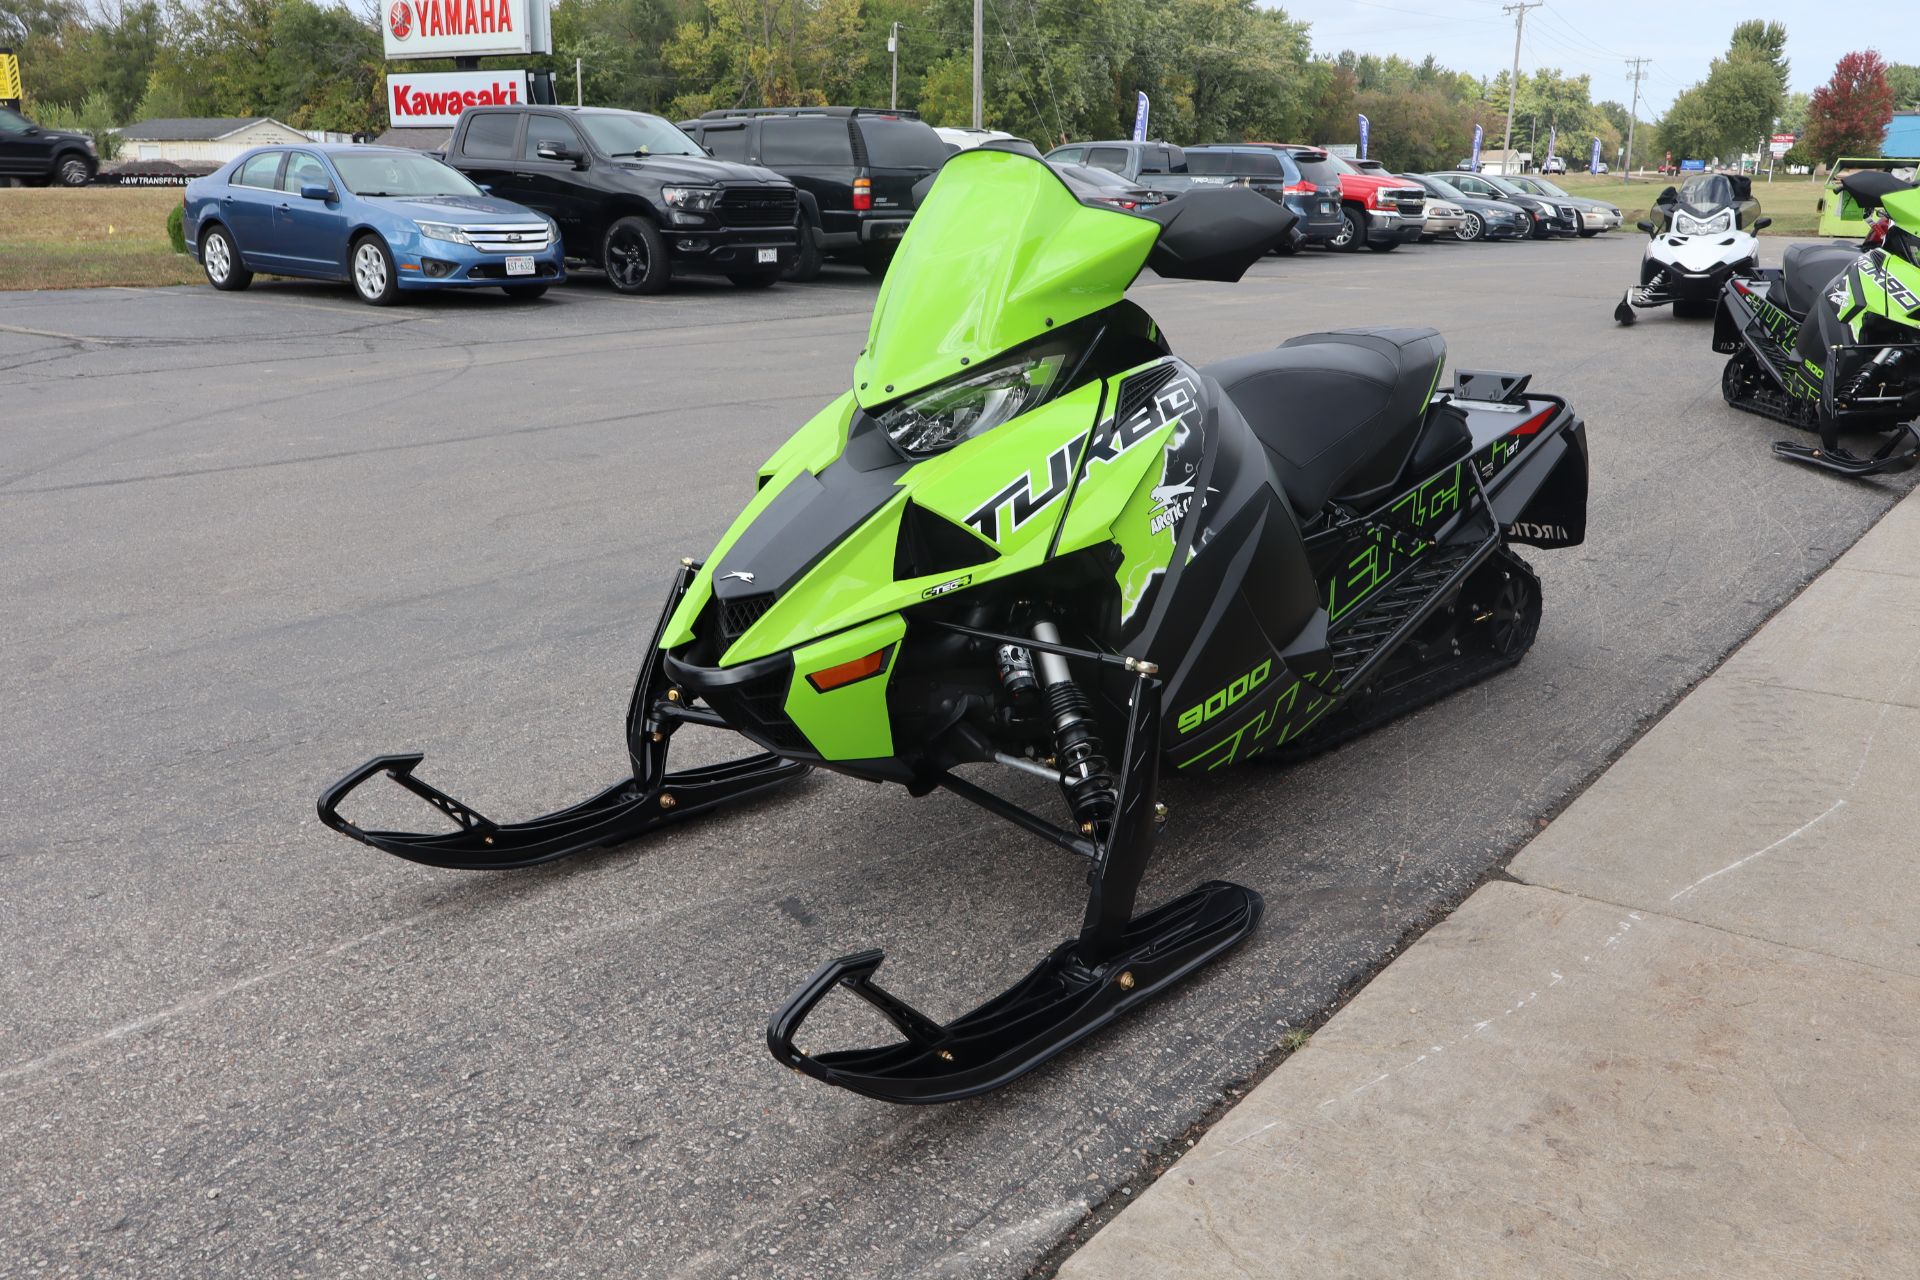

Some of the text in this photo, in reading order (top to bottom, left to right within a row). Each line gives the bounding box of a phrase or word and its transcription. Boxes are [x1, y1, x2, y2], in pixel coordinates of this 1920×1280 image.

[415, 0, 513, 37] YAMAHA
[393, 82, 517, 116] Kawasaki
[963, 377, 1198, 545] TURBO
[1150, 503, 1184, 536] ARCTIC
[1178, 658, 1272, 735] 9000
